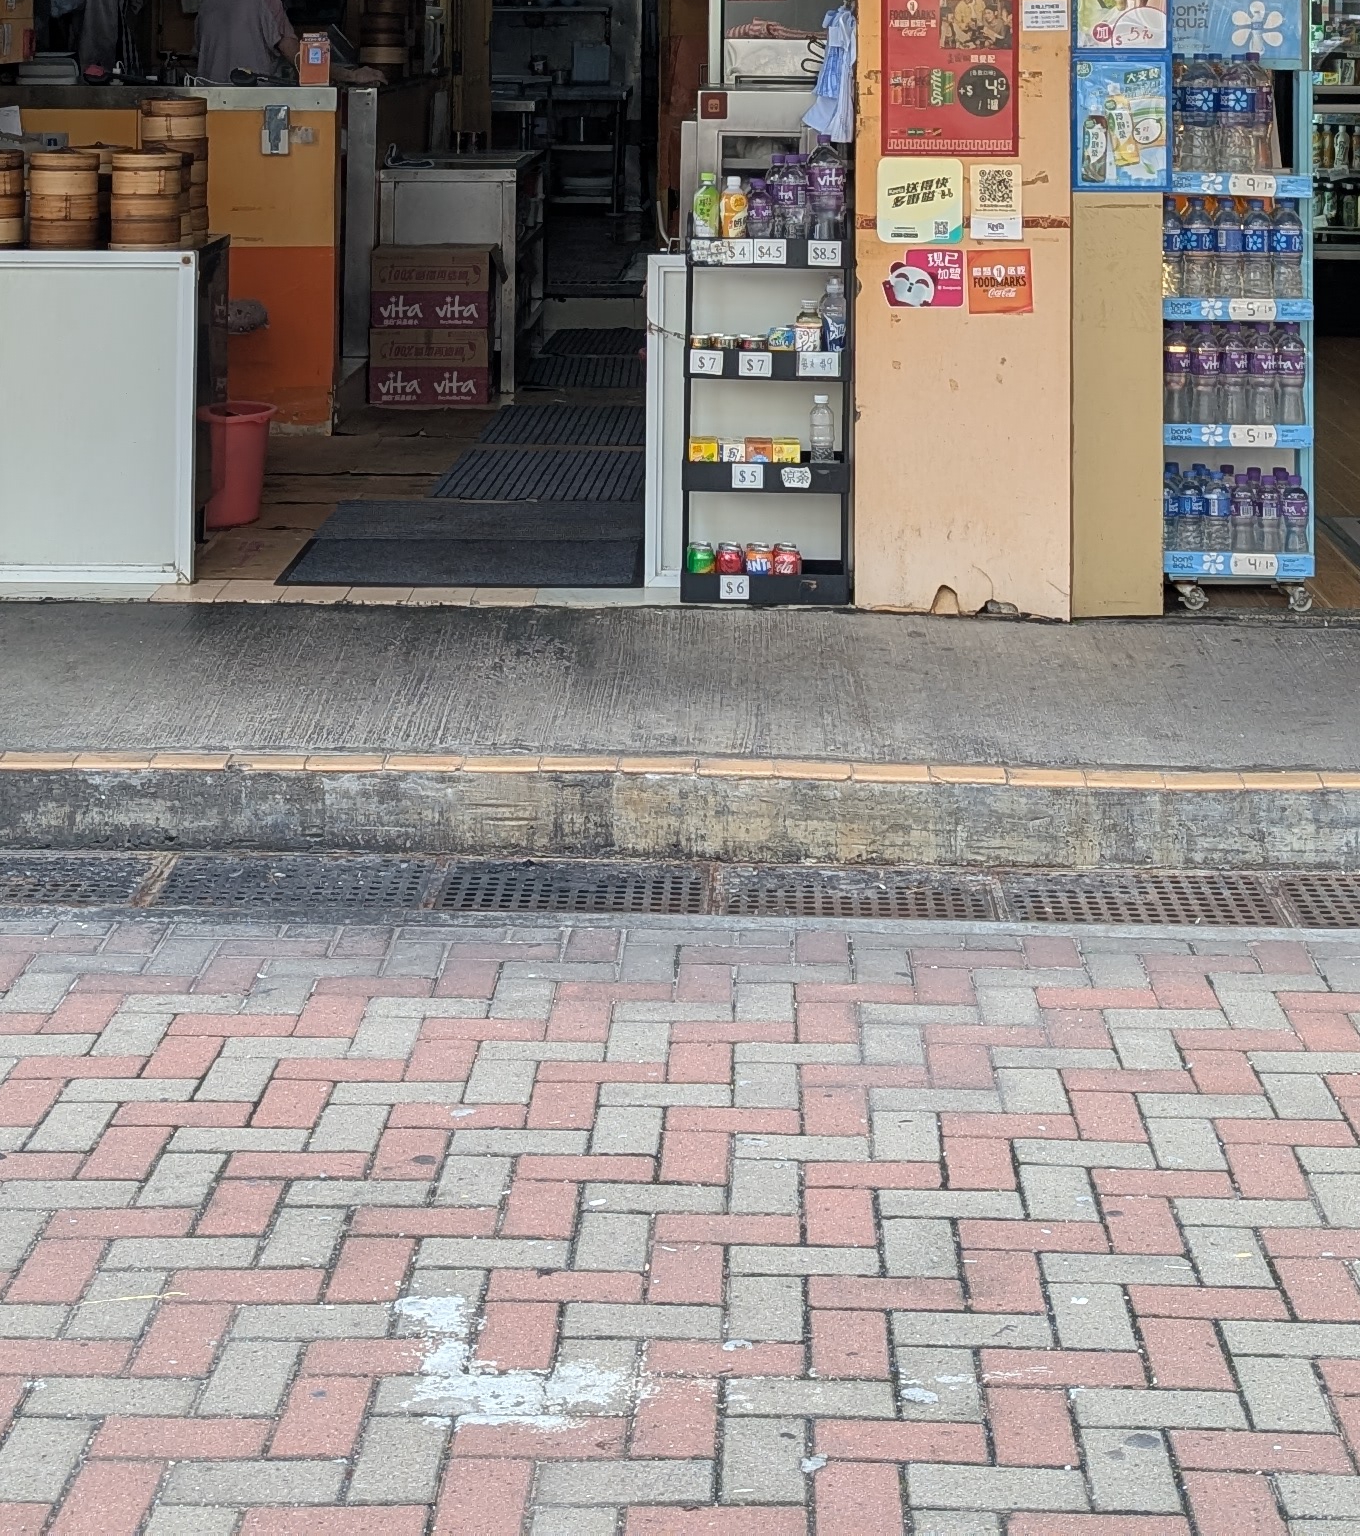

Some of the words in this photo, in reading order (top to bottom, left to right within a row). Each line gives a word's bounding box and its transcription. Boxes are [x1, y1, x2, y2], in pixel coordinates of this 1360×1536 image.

[757, 246, 782, 260] $4.5
[812, 247, 837, 260] $8.5
[927, 251, 959, 268] 現已
[937, 267, 961, 281] 加盟
[379, 295, 423, 318] vita
[435, 295, 479, 318] vita
[377, 371, 422, 394] vita
[433, 370, 477, 395] vita
